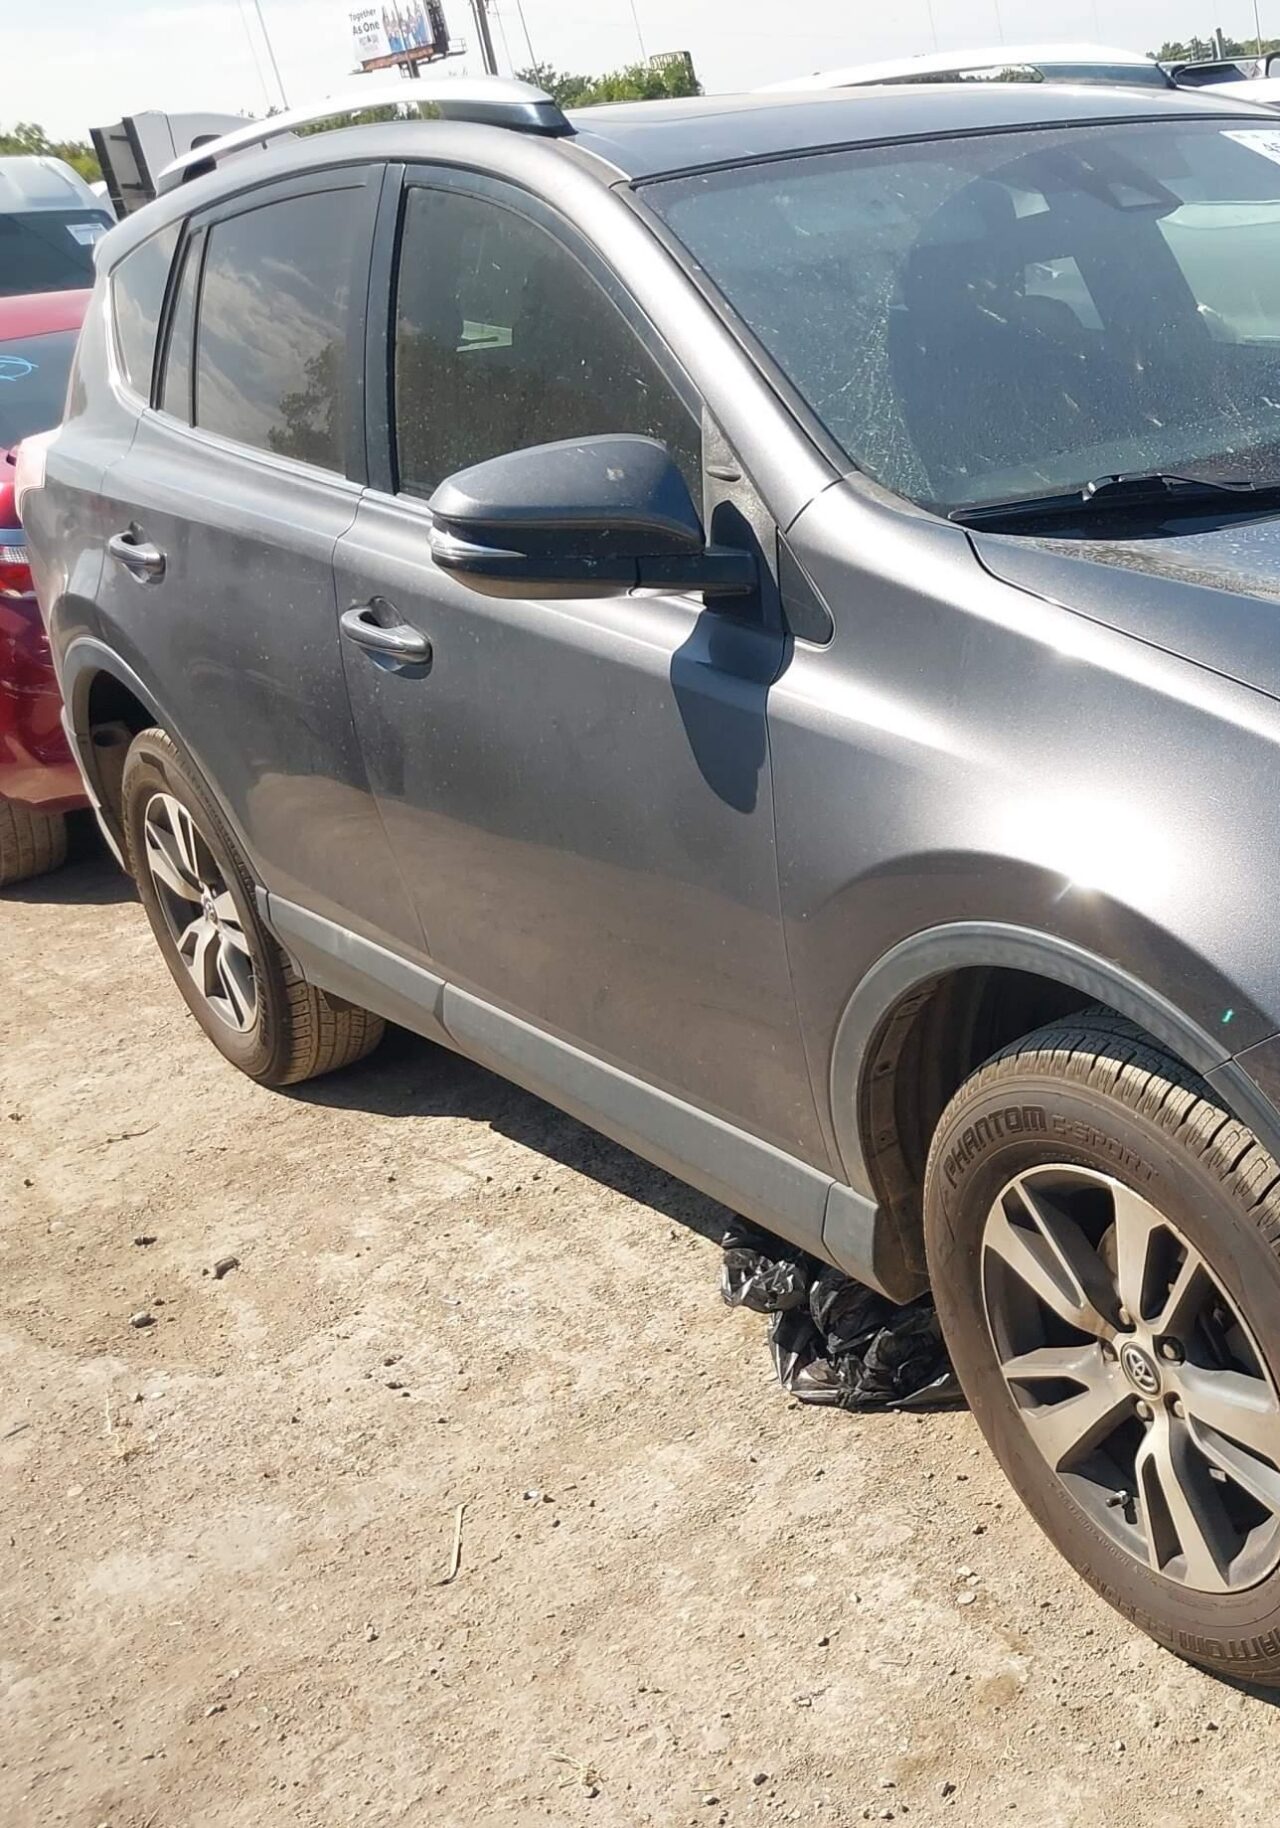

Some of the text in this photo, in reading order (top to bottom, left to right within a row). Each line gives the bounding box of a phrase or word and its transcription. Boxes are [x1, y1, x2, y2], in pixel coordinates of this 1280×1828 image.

[348, 8, 376, 22] Together
[352, 20, 380, 36] As One
[943, 1105, 1048, 1189] PHANTOM
